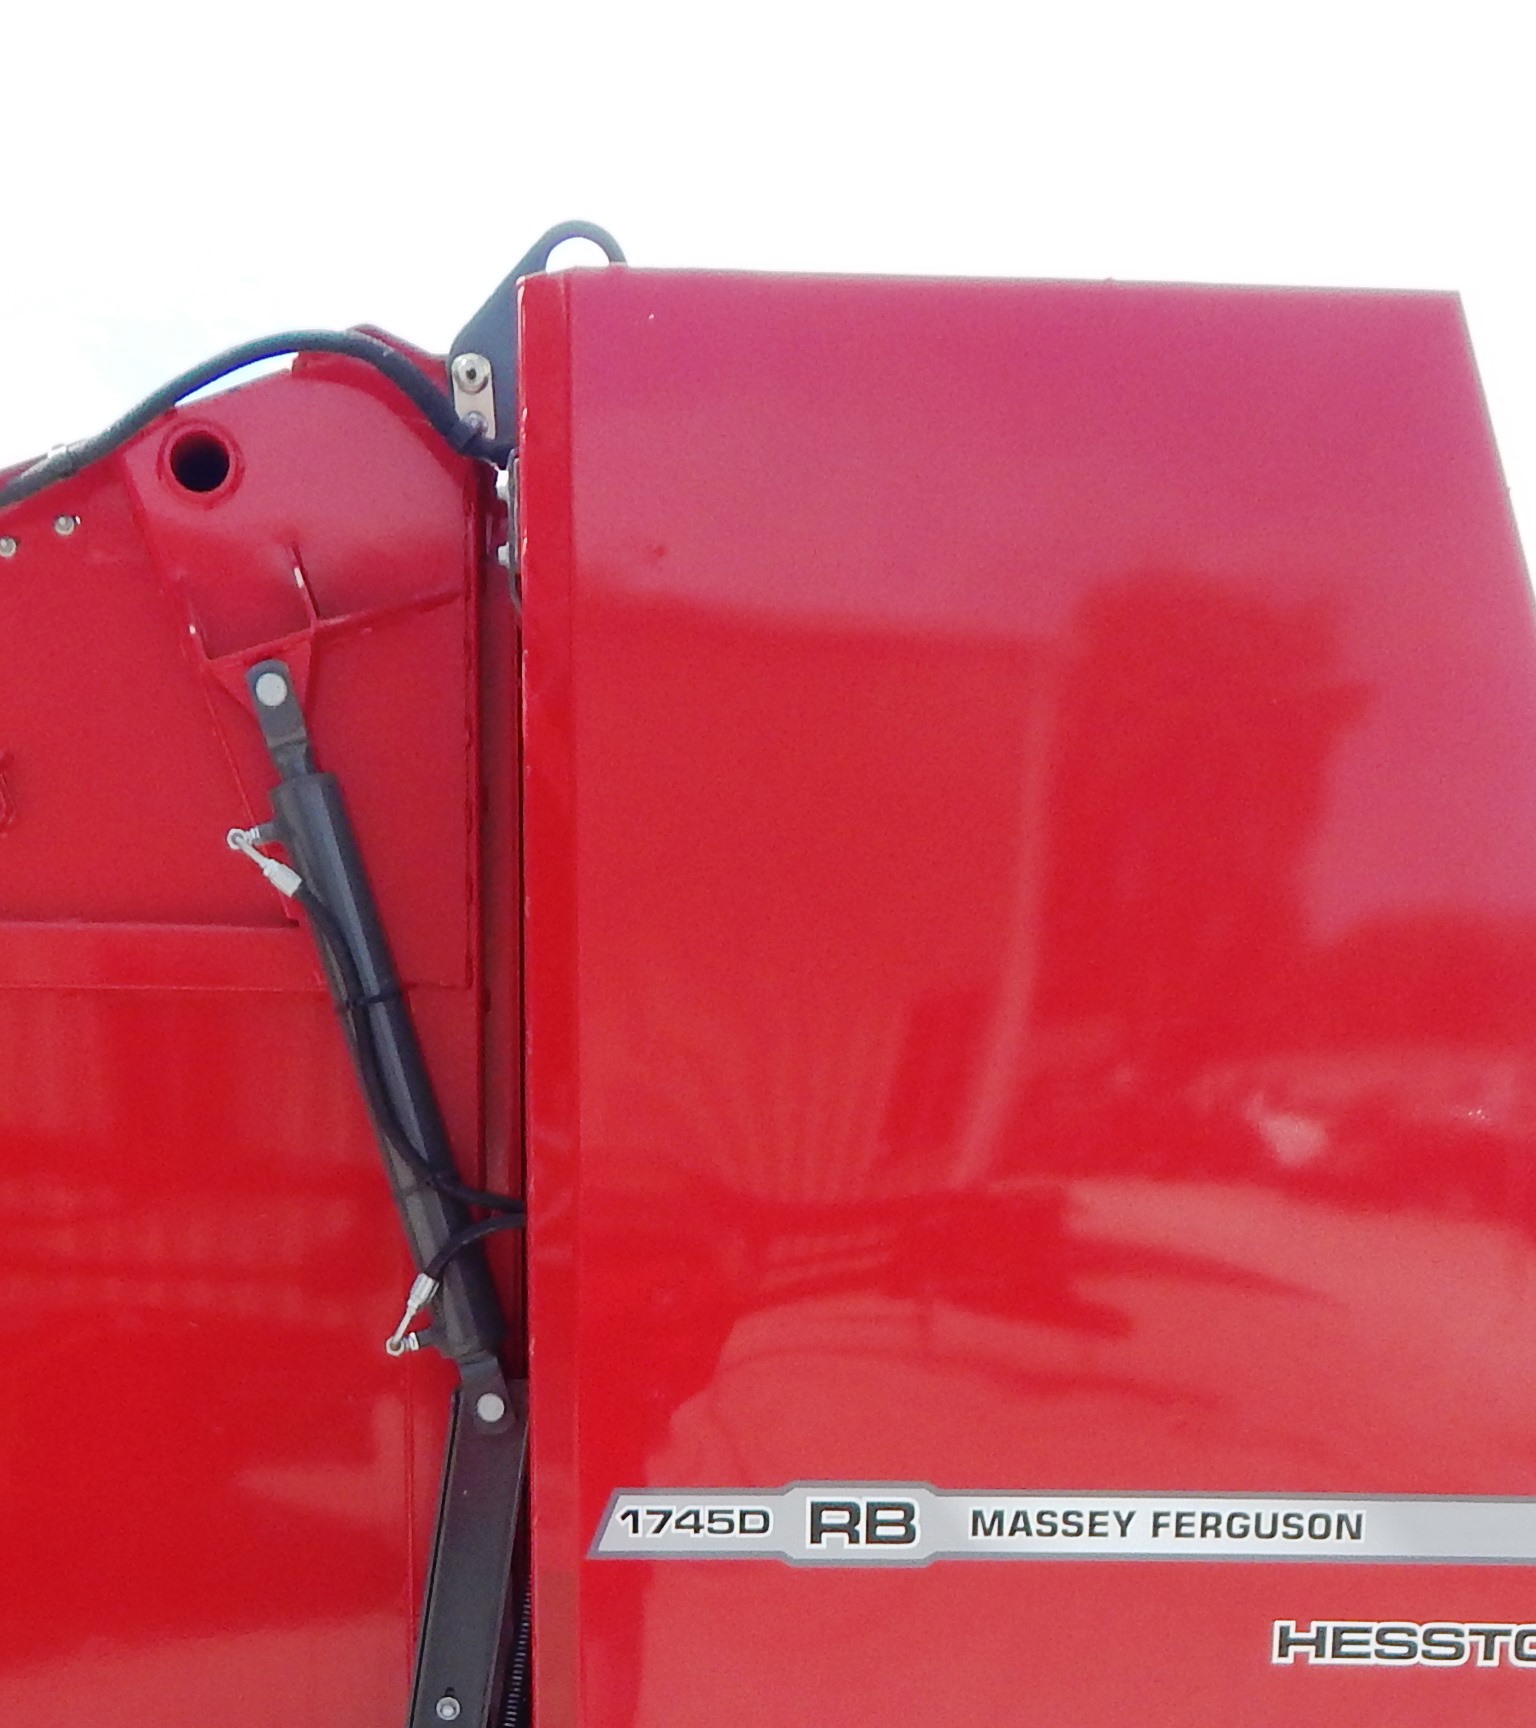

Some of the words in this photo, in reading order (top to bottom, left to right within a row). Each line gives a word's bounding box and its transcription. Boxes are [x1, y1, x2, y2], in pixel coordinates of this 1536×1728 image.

[619, 1508, 771, 1536] 1745D
[809, 1500, 917, 1546] RB
[970, 1509, 1137, 1539] MASSEY
[1151, 1510, 1365, 1541] FERGUSON
